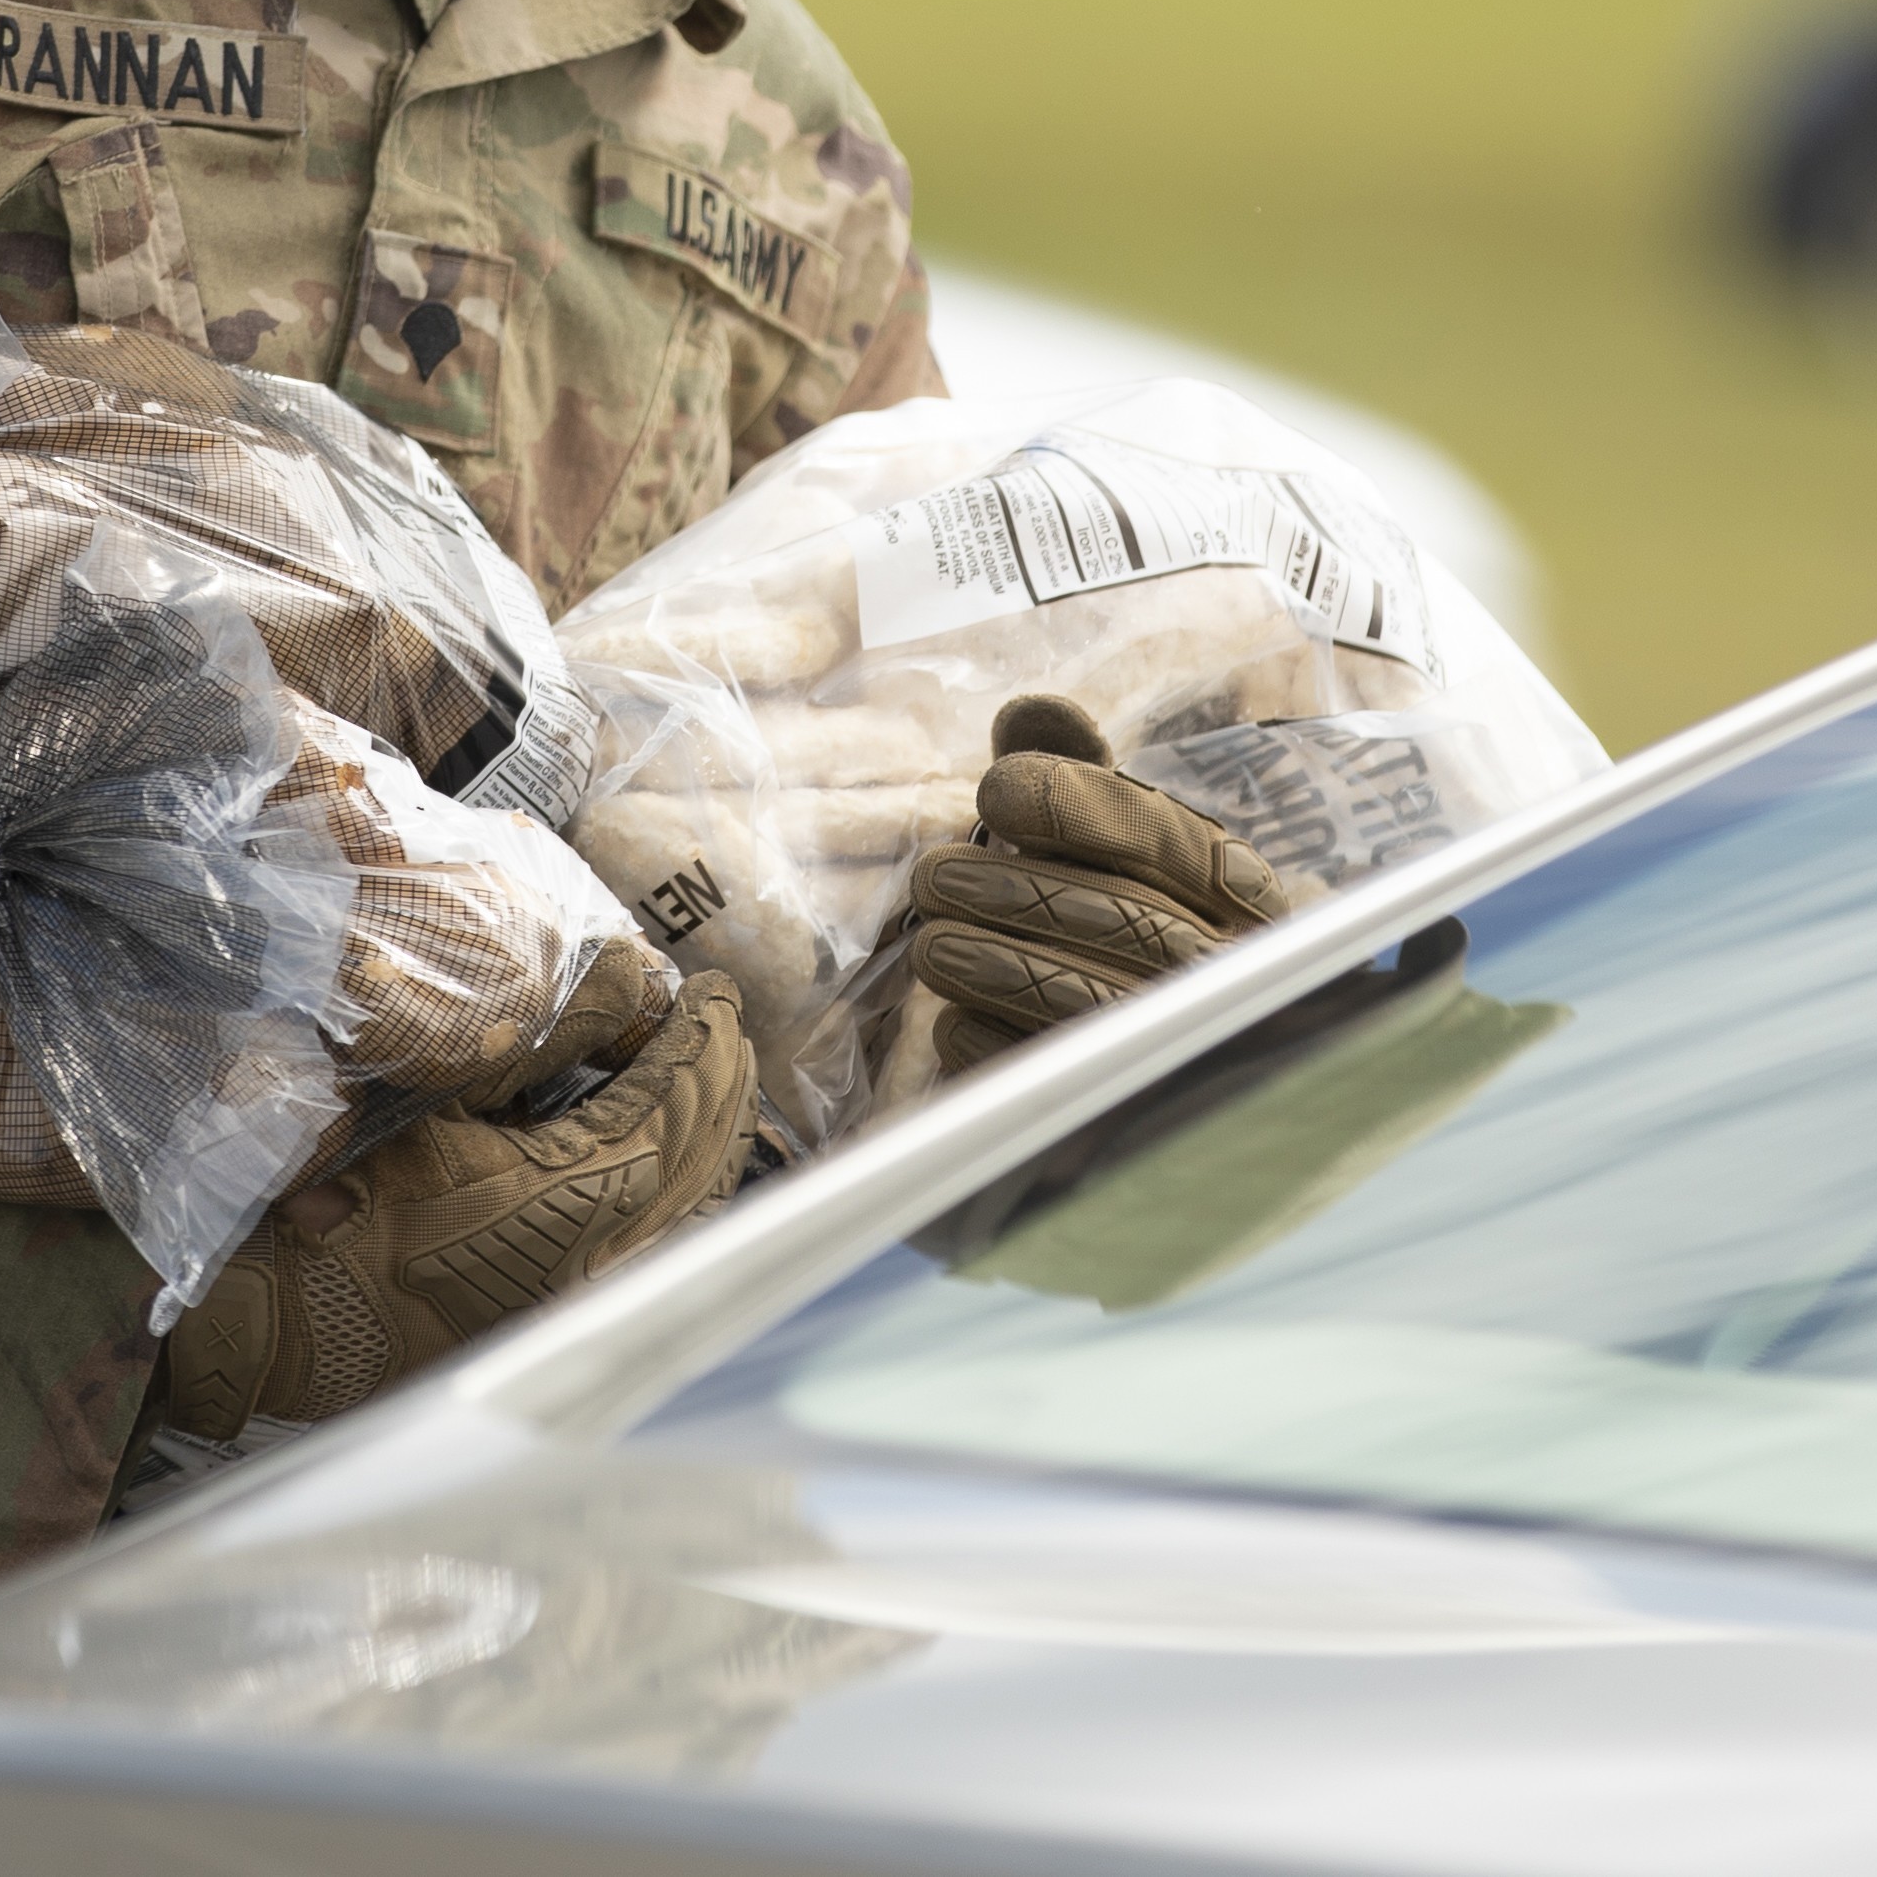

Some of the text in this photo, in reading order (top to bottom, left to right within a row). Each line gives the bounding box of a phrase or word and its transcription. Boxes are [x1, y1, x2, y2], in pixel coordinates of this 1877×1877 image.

[963, 494, 987, 530] LESS
[1030, 514, 1049, 549] 2,000
[1043, 507, 1064, 551] nutrient
[917, 497, 946, 550] CHICKEN
[935, 551, 951, 582] FAT.
[936, 497, 956, 534] FOOD
[946, 533, 969, 590] STARCH,
[958, 527, 982, 583] FLAVOR,
[973, 528, 992, 550] OF
[981, 491, 1003, 530] MEAT
[992, 527, 1012, 561] WITH
[1002, 561, 1020, 584] RIB
[1074, 525, 1105, 582] Iron 2%
[1102, 535, 1120, 552] C
[1193, 532, 1209, 555] 0%
[1215, 530, 1230, 555] 0%
[979, 547, 1007, 597] SODIUM
[1039, 548, 1061, 589] calories
[1108, 551, 1128, 577] 2%
[533, 712, 551, 729] Iron
[524, 729, 564, 762] Potassium
[504, 759, 532, 786] Vitamin
[531, 785, 555, 809] 0.2mg
[518, 745, 546, 772] Vitamin
[544, 770, 566, 791] 27mg
[489, 781, 502, 793] The
[500, 792, 515, 807] Daily
[636, 857, 728, 947] NET
